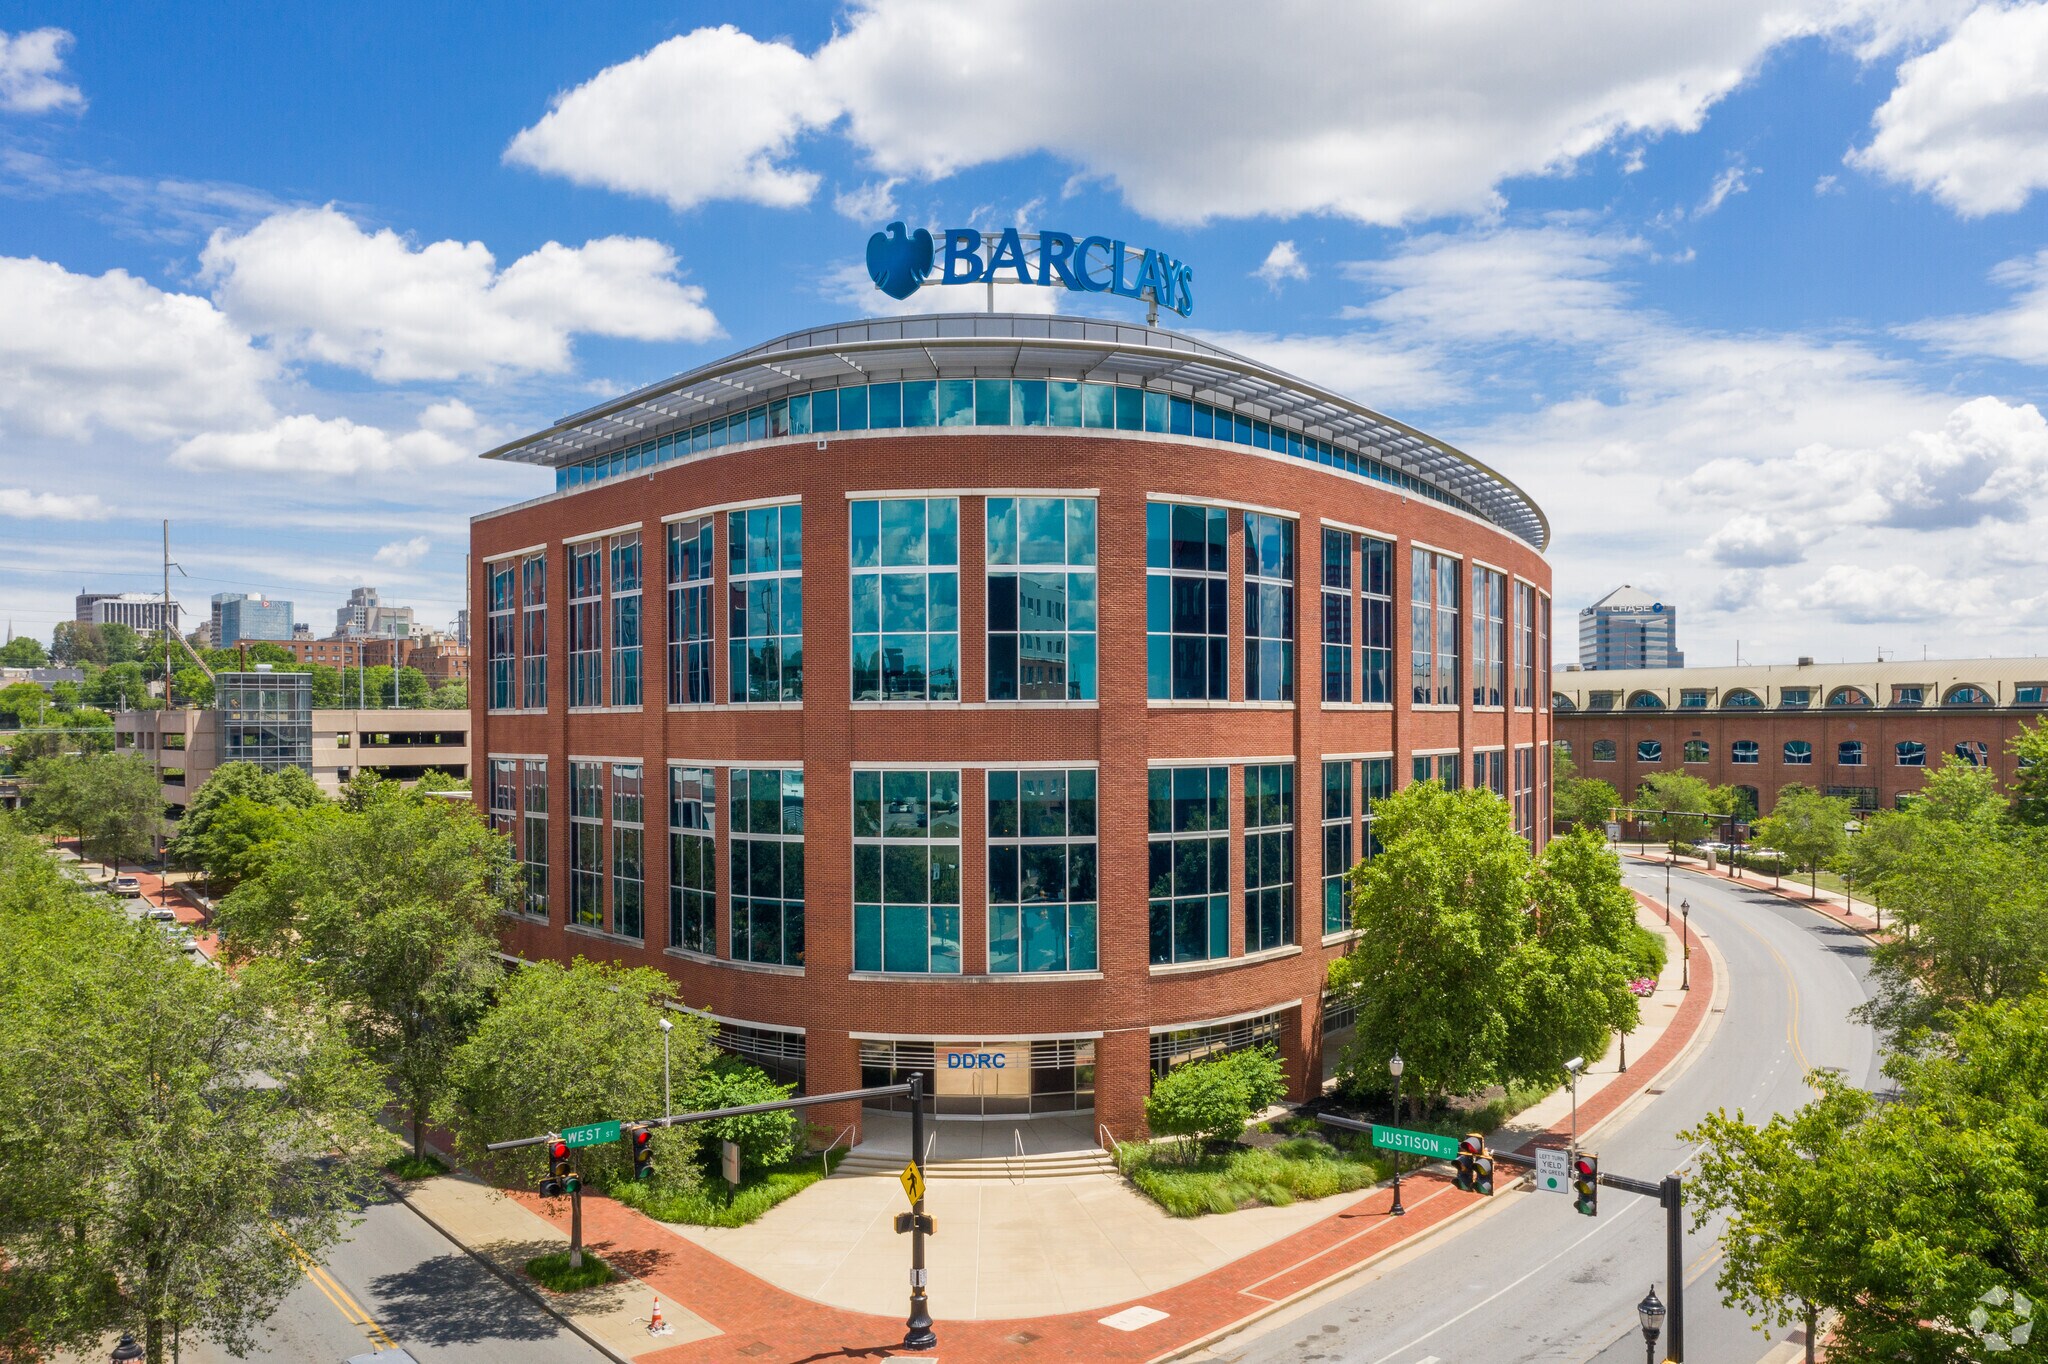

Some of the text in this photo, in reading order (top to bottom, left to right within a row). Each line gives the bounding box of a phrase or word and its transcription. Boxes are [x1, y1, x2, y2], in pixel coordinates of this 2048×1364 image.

[941, 228, 1193, 318] BARCLAYS
[1611, 604, 1651, 612] CHASE
[948, 1053, 1006, 1069] DDRC
[568, 1128, 614, 1143] WEST ST
[1379, 1131, 1452, 1155] JUSTISON ST
[1542, 1160, 1562, 1170] YIELD
[1548, 1169, 1565, 1177] GREEN
